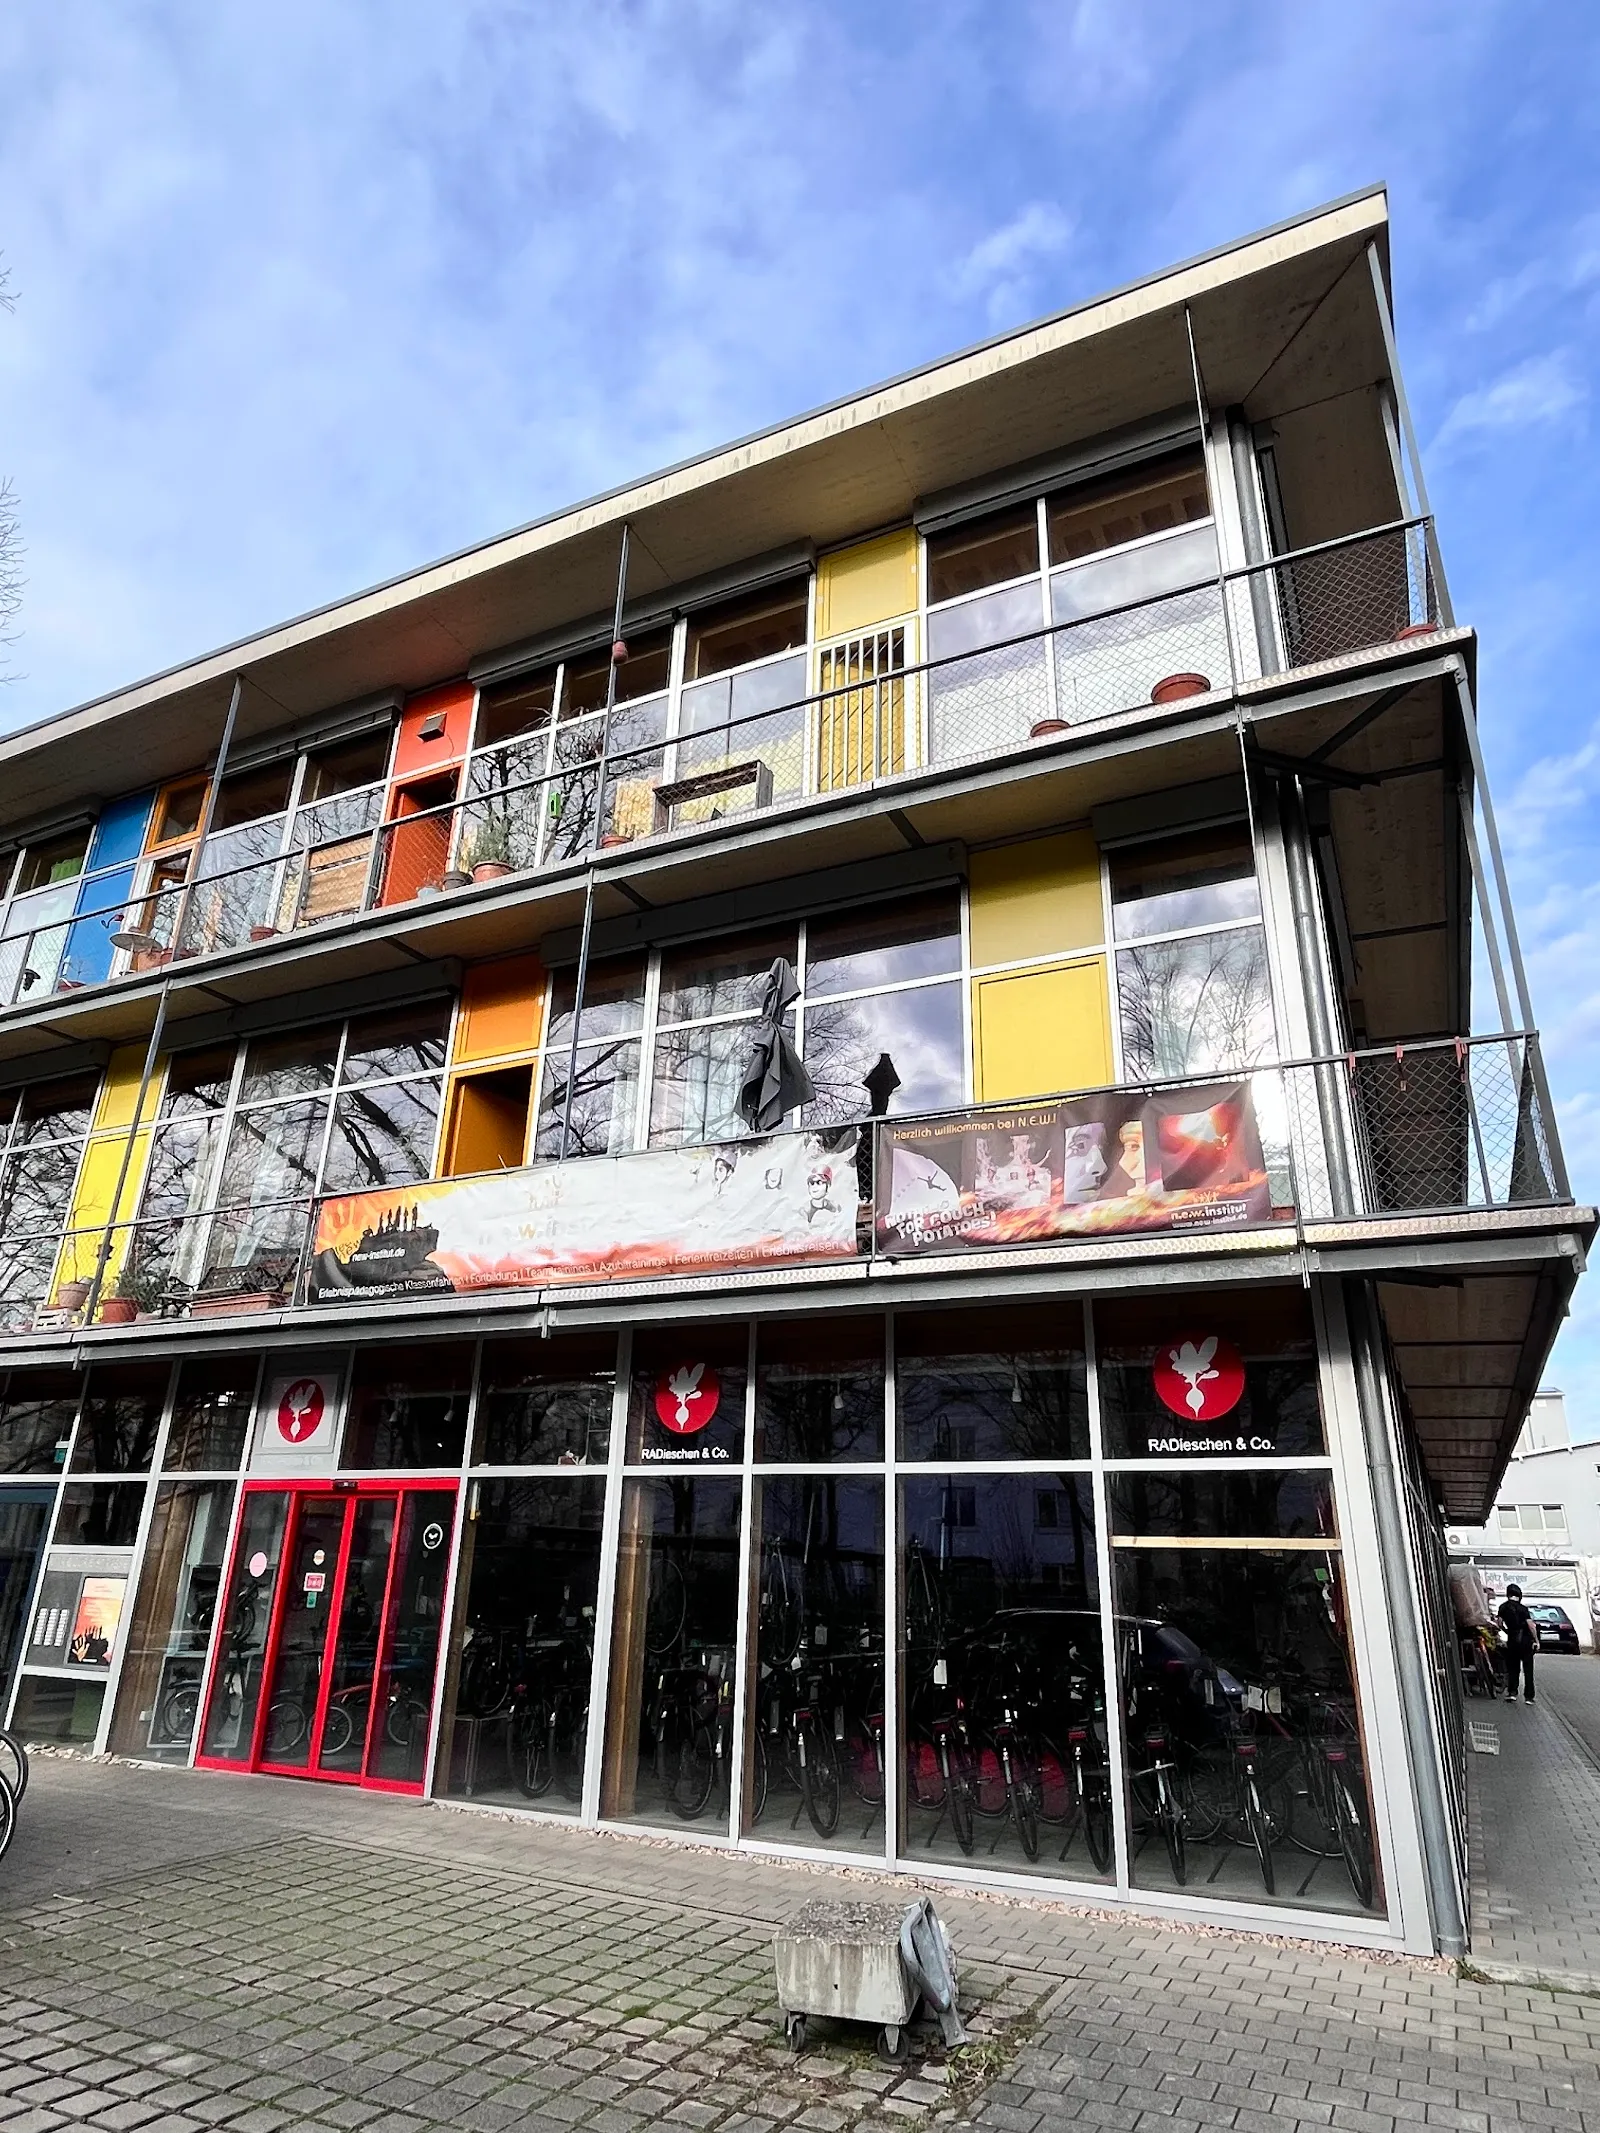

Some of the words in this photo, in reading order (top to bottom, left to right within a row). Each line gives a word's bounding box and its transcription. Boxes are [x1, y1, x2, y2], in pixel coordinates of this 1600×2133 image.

[893, 1127, 932, 1140] Herzlich
[934, 1121, 995, 1137] willkommen
[997, 1119, 1016, 1130] bei
[896, 1213, 925, 1240] FOR
[929, 1201, 985, 1227] COUCH
[1236, 1437, 1247, 1450] &
[1250, 1436, 1276, 1450] Co.
[702, 1447, 710, 1459] &
[711, 1446, 730, 1459] Co.
